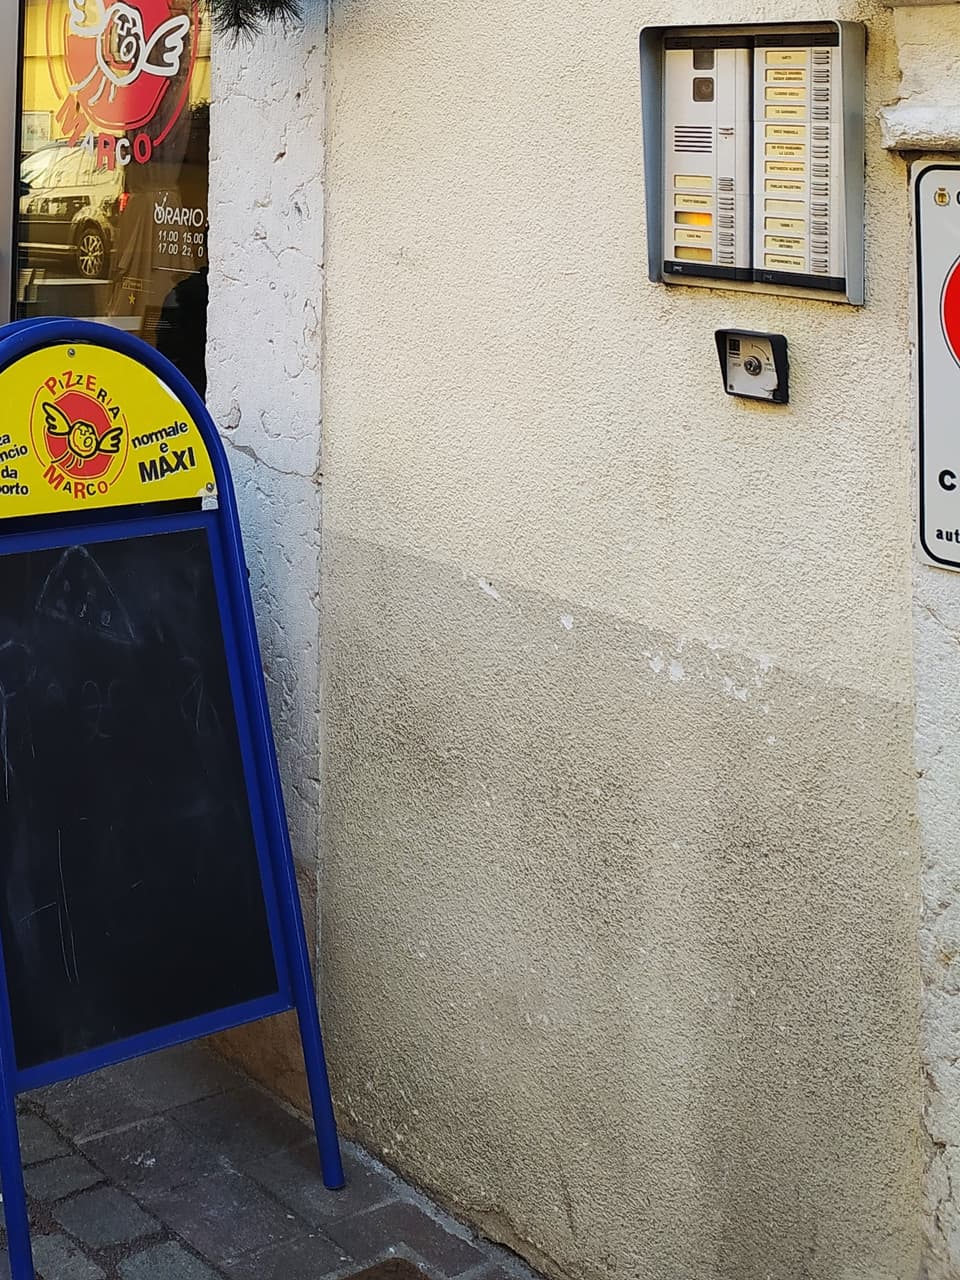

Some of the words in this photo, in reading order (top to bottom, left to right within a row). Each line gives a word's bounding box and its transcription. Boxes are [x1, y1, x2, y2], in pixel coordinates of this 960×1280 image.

[55, 94, 152, 170] MARCO
[43, 370, 121, 420] PIZZERIA
[131, 421, 189, 449] normale
[159, 441, 169, 454] e
[1, 465, 18, 479] da
[42, 464, 109, 500] MARCO
[138, 446, 196, 483] MAXI
